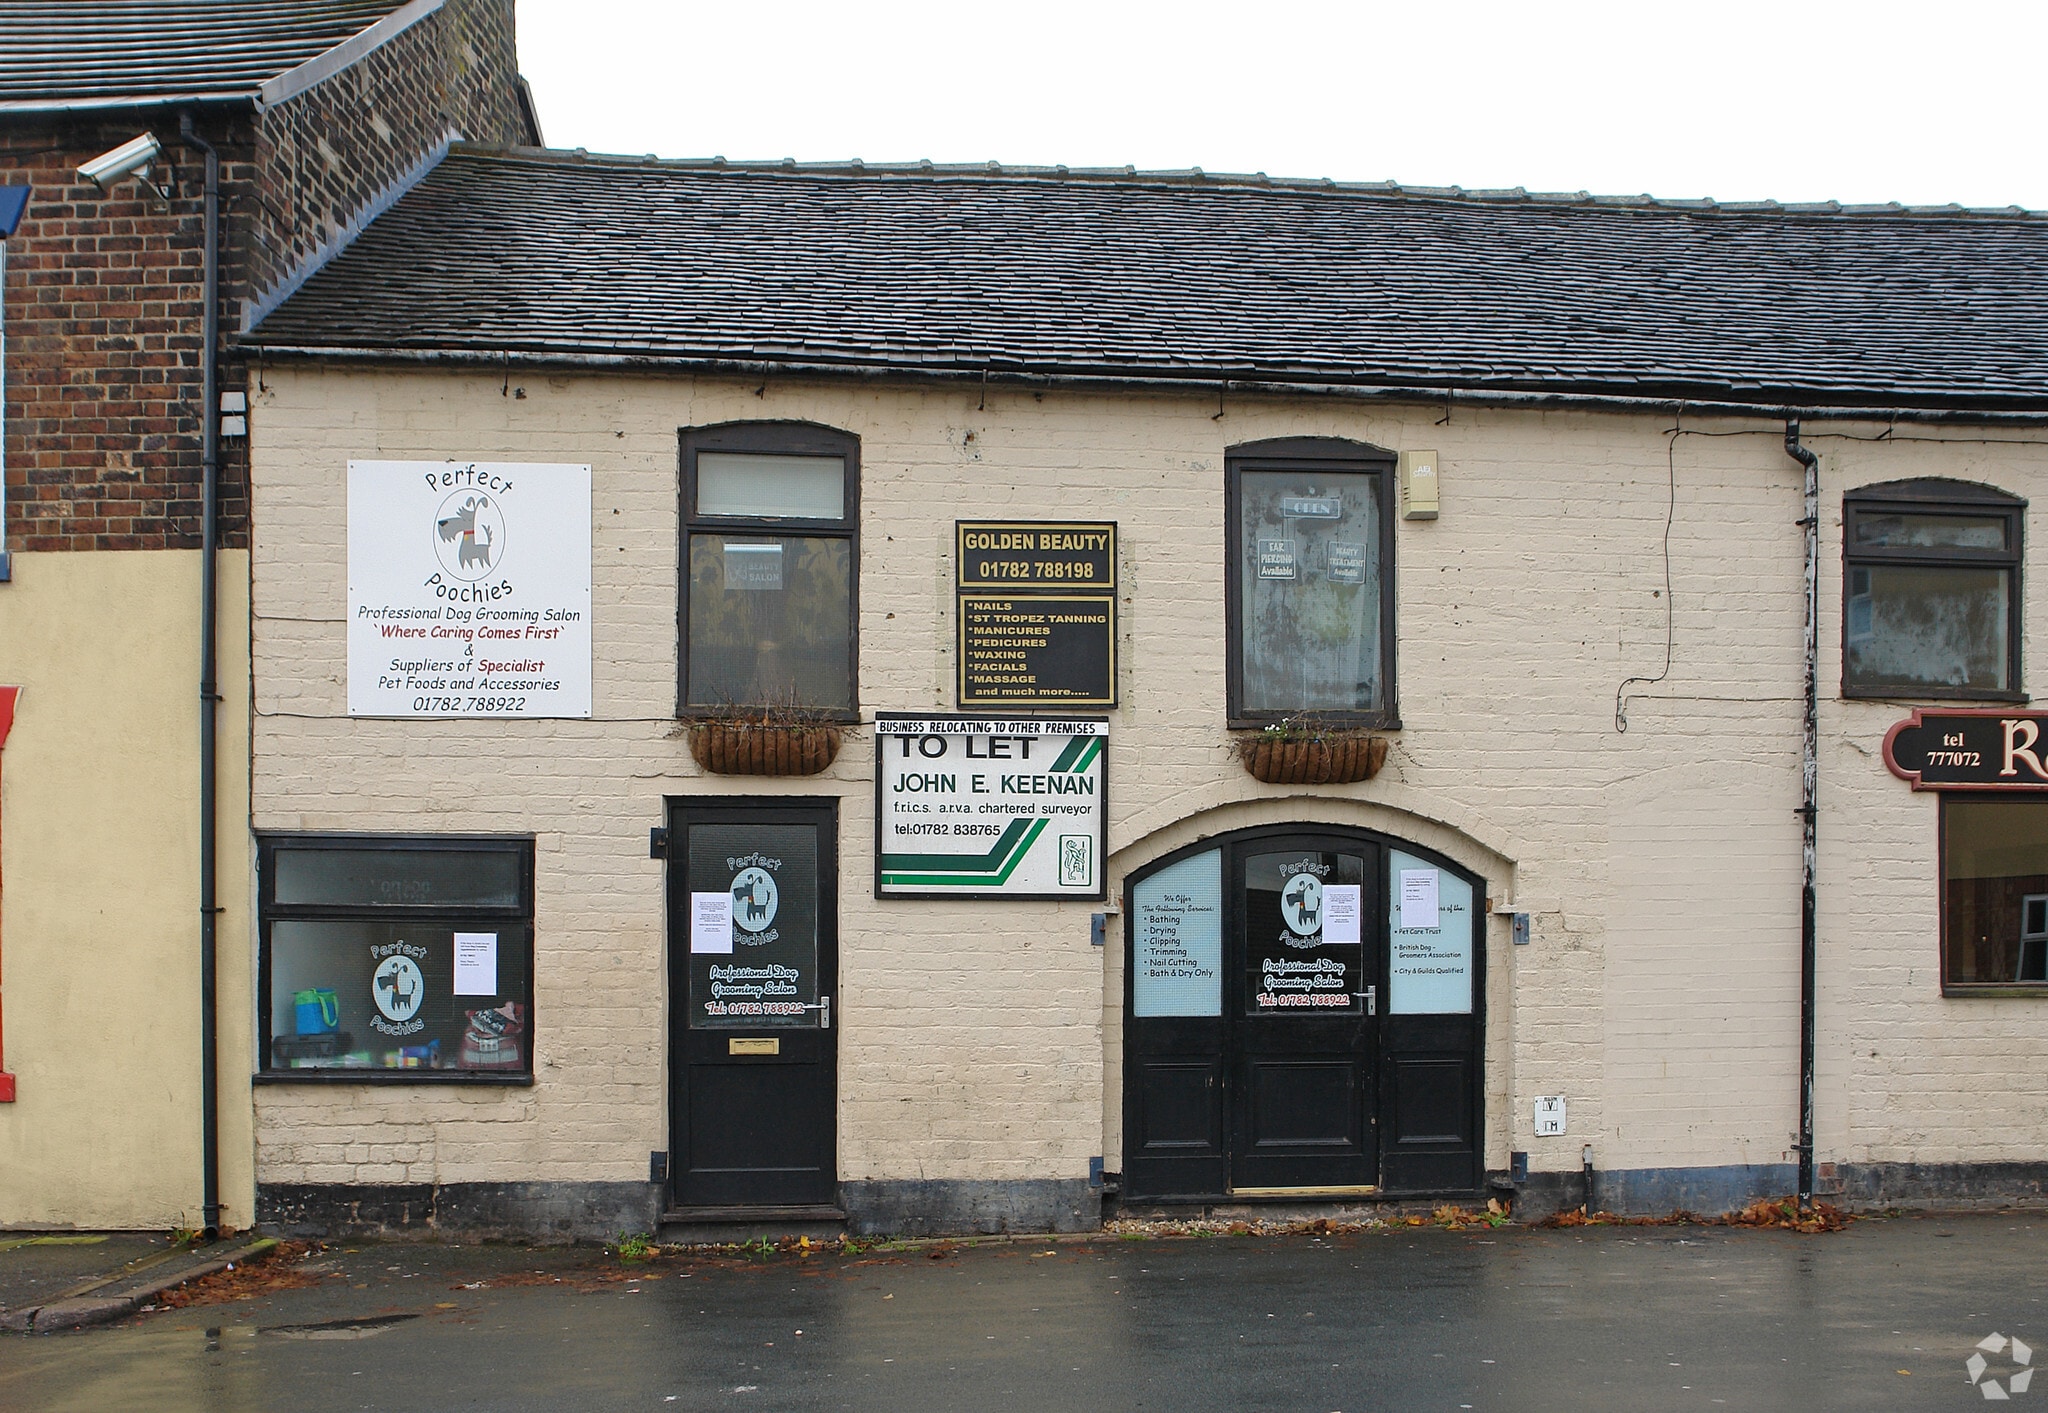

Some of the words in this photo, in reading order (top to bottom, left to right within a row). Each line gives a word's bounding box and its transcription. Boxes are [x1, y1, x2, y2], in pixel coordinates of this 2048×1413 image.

[424, 464, 513, 494] Perfect
[965, 533, 1034, 550] GOLDEN
[1039, 534, 1108, 551] BEAUTY
[1269, 543, 1284, 552] EAR
[979, 561, 1030, 578] 01782
[1034, 562, 1094, 578] 788198
[749, 573, 780, 582] SALON
[424, 572, 513, 603] Poochies
[358, 605, 442, 620] Professional
[446, 606, 471, 623] Dog
[475, 608, 539, 624] Grooming
[543, 609, 581, 622] Salon
[993, 614, 1045, 623] TROPEZ
[1048, 615, 1107, 624] TANNING
[430, 625, 474, 642] Caring
[477, 626, 521, 639] Comes
[464, 643, 474, 656] &
[389, 658, 453, 675] Suppliers
[457, 659, 474, 672] of
[478, 659, 545, 675] Specialist
[378, 676, 401, 689] Pet
[405, 676, 446, 690] Foods
[449, 676, 474, 690] and
[478, 677, 560, 691] Accessories
[975, 687, 998, 696] and
[1002, 687, 1036, 696] much
[413, 697, 526, 712] 01782.788922
[879, 721, 925, 733] BUSINESS
[929, 721, 993, 733] RELOCATING
[994, 722, 1006, 733] TO
[1008, 722, 1041, 734] OTHER
[1045, 723, 1096, 734] PREMISES
[893, 734, 948, 758] TO
[966, 735, 1039, 760] LET
[1943, 732, 1964, 747] tel
[1999, 719, 2048, 780] R
[1927, 752, 1980, 767] 777072
[893, 773, 956, 794] JOHN
[972, 774, 990, 794] E.
[1001, 775, 1094, 795] KEENAN
[893, 802, 932, 813] f.r.i.c.s.
[939, 804, 973, 814] a.r.v.a.
[978, 803, 1035, 814] chartered
[1041, 805, 1092, 816] surveyor
[895, 823, 949, 835] tel:01782
[953, 824, 1001, 836] 838765
[1175, 894, 1191, 904] Offer
[1155, 905, 1185, 914] Following
[1149, 915, 1180, 925] Bathing
[1149, 926, 1176, 936] Drying
[1149, 937, 1180, 946] Clipping
[1279, 930, 1322, 949] Poochie
[1149, 948, 1187, 957] Trimming
[1167, 958, 1197, 968] Cutting
[1262, 958, 1321, 976] Professional
[1321, 958, 1346, 976] Dog
[709, 964, 772, 982] Professional
[773, 965, 799, 982] Dog
[1149, 969, 1169, 977] Bath
[1178, 969, 1193, 978] Dry
[1194, 968, 1213, 978] Only
[711, 982, 762, 998] Grooming
[763, 981, 798, 995] Salon
[1263, 974, 1312, 992] Grooming
[1312, 974, 1344, 988] Salon
[1257, 992, 1277, 1006] Tel:
[1278, 993, 1311, 1006] 01782
[1310, 993, 1350, 1007] 788922
[705, 1001, 727, 1015] Tel:
[728, 1002, 761, 1015] 01782
[762, 1002, 806, 1015] 788922
[369, 1014, 425, 1036] Poochies
